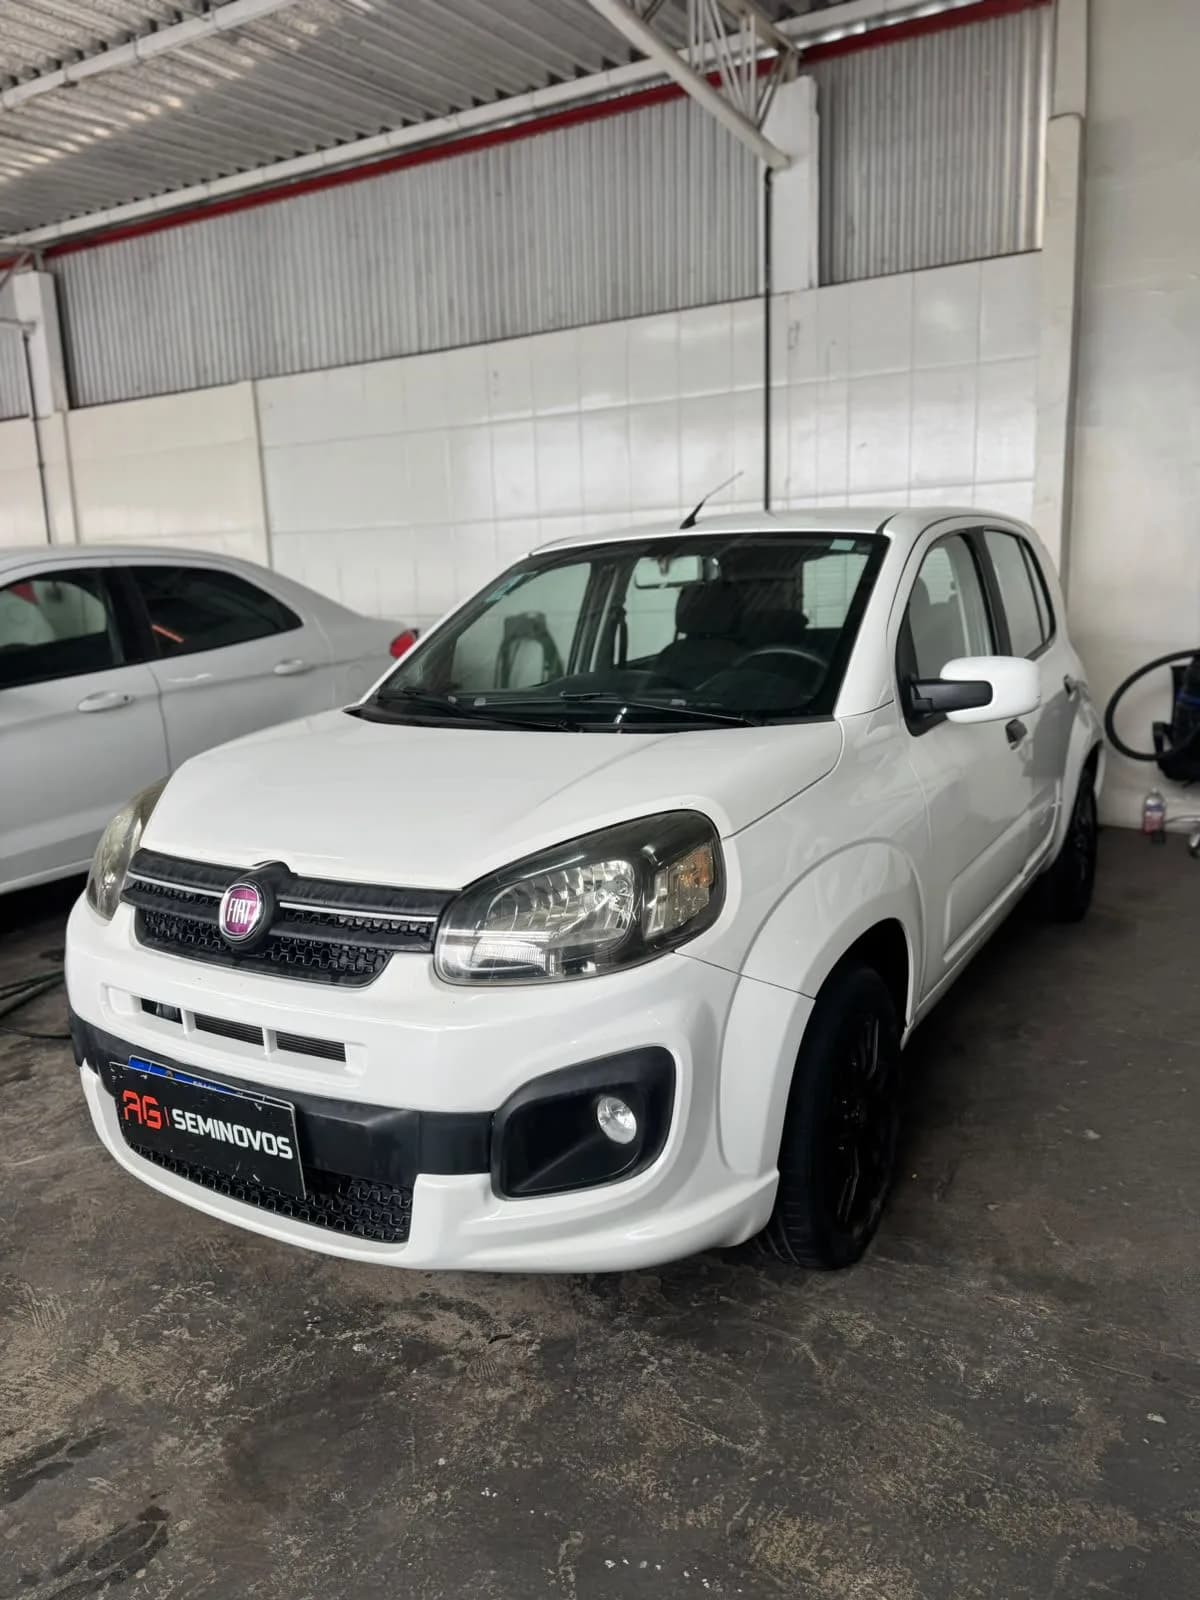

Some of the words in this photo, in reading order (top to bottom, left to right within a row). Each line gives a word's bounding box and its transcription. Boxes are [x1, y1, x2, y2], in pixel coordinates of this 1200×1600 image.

[226, 898, 257, 924] FIAT
[123, 1090, 162, 1130] AG
[172, 1108, 293, 1160] SEMINOVOS
